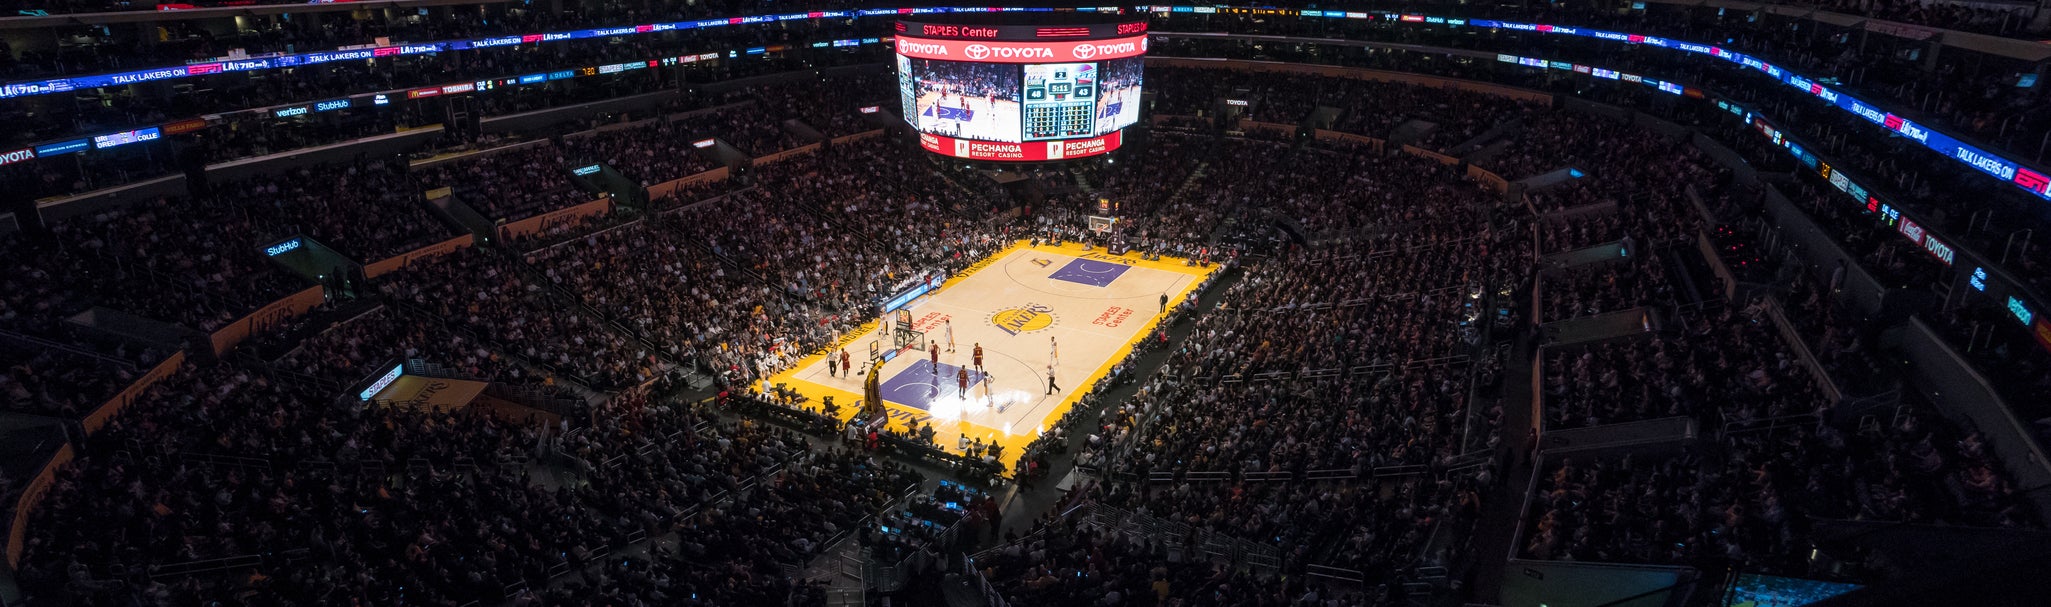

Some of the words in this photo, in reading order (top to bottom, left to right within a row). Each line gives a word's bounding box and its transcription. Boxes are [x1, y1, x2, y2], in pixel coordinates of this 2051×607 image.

[923, 25, 958, 36] STAPLES
[962, 26, 998, 38] Center
[1118, 23, 1140, 35] STAPLES
[490, 38, 512, 46] LAKERS
[522, 34, 544, 43] ESPN
[543, 33, 551, 41] LA
[330, 53, 360, 61] LAKERS
[374, 47, 401, 57] ESPN
[909, 42, 948, 56] TOYOTA
[992, 48, 1054, 58] TOYOTA
[1097, 43, 1135, 55] TOYOTA
[1690, 44, 1703, 52] LAKERS
[113, 75, 137, 85] TALK
[138, 70, 172, 82] LAKERS
[173, 69, 186, 78] ON
[188, 63, 223, 75] ESPN
[222, 63, 235, 72] LA
[554, 71, 574, 79] DELTA
[1622, 73, 1642, 83] TOYOTA
[0, 86, 13, 97] LA
[18, 85, 39, 94] 710
[442, 83, 474, 94] TOSHIBA
[317, 100, 349, 111] StubHub
[276, 107, 307, 118] verizon
[1852, 102, 1863, 114] TALK
[1862, 105, 1879, 122] LAKERS
[1878, 113, 1886, 124] ON
[972, 144, 1022, 153] PECHANGA
[1066, 139, 1105, 151] PECHANGA
[0, 149, 34, 166] YOTA
[1957, 147, 1974, 164] TALK
[1972, 152, 2002, 175] LAKERS
[2001, 166, 2015, 180] ON
[2014, 167, 2051, 194] ESPN
[267, 240, 299, 257] StubHub
[1925, 234, 1954, 266] TOYOTA
[1092, 306, 1121, 326] STAPLES
[2008, 295, 2032, 326] verizon
[996, 304, 1054, 337] LAKERS
[1106, 308, 1134, 328] Center
[369, 371, 395, 397] STAPLES
